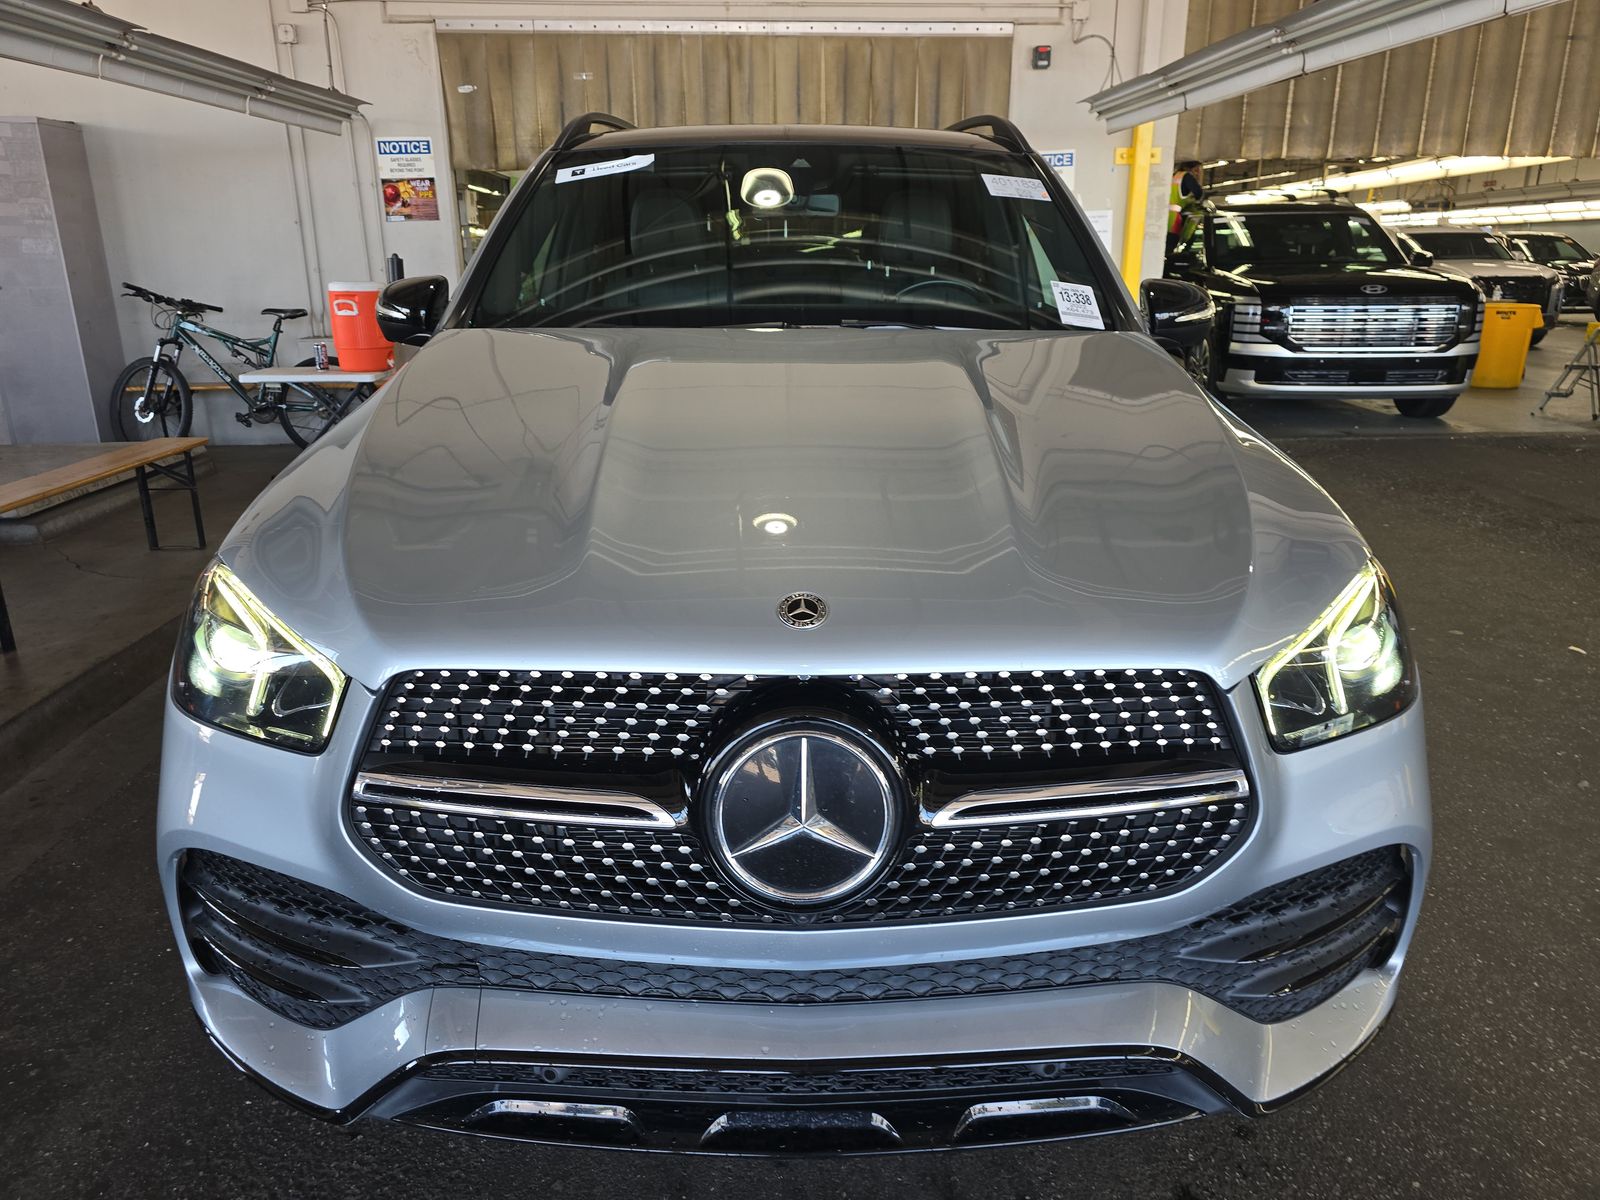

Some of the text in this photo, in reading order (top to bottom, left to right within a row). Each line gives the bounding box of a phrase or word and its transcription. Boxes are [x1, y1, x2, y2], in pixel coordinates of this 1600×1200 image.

[380, 142, 429, 153] NOTICE
[1042, 153, 1072, 166] TICE
[1059, 291, 1092, 306] 13:338
